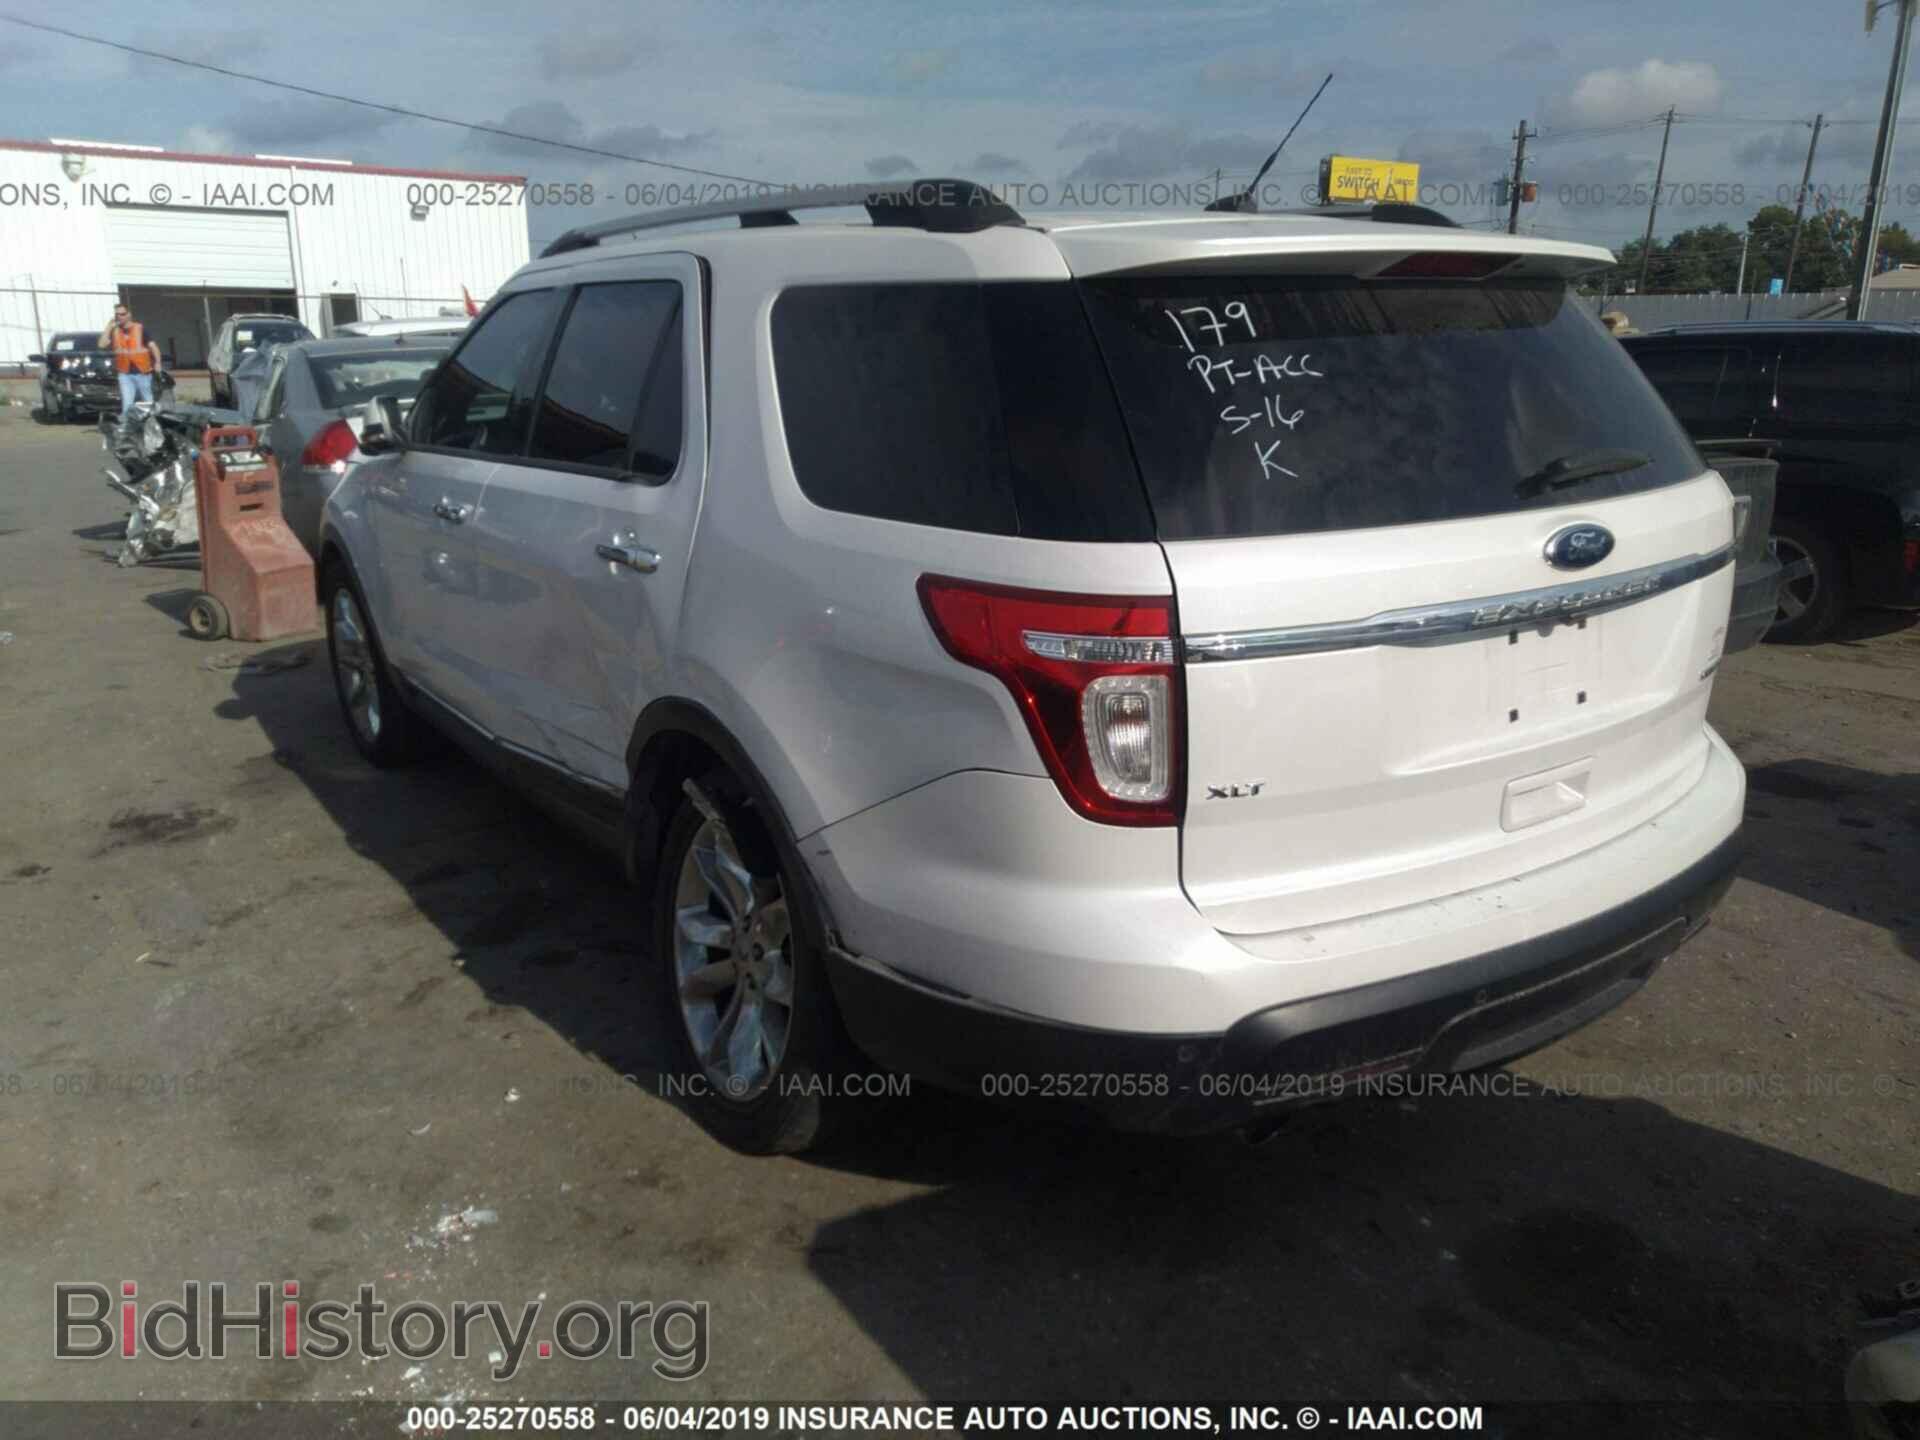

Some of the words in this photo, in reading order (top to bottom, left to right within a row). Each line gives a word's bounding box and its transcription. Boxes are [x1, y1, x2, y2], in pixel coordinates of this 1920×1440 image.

[1337, 175, 1381, 191] SWITCH
[1165, 301, 1257, 352] 179
[1187, 354, 1324, 393] PT-ACC
[1220, 394, 1304, 434] S-16
[1254, 440, 1299, 480] K
[1206, 782, 1265, 800] XLT
